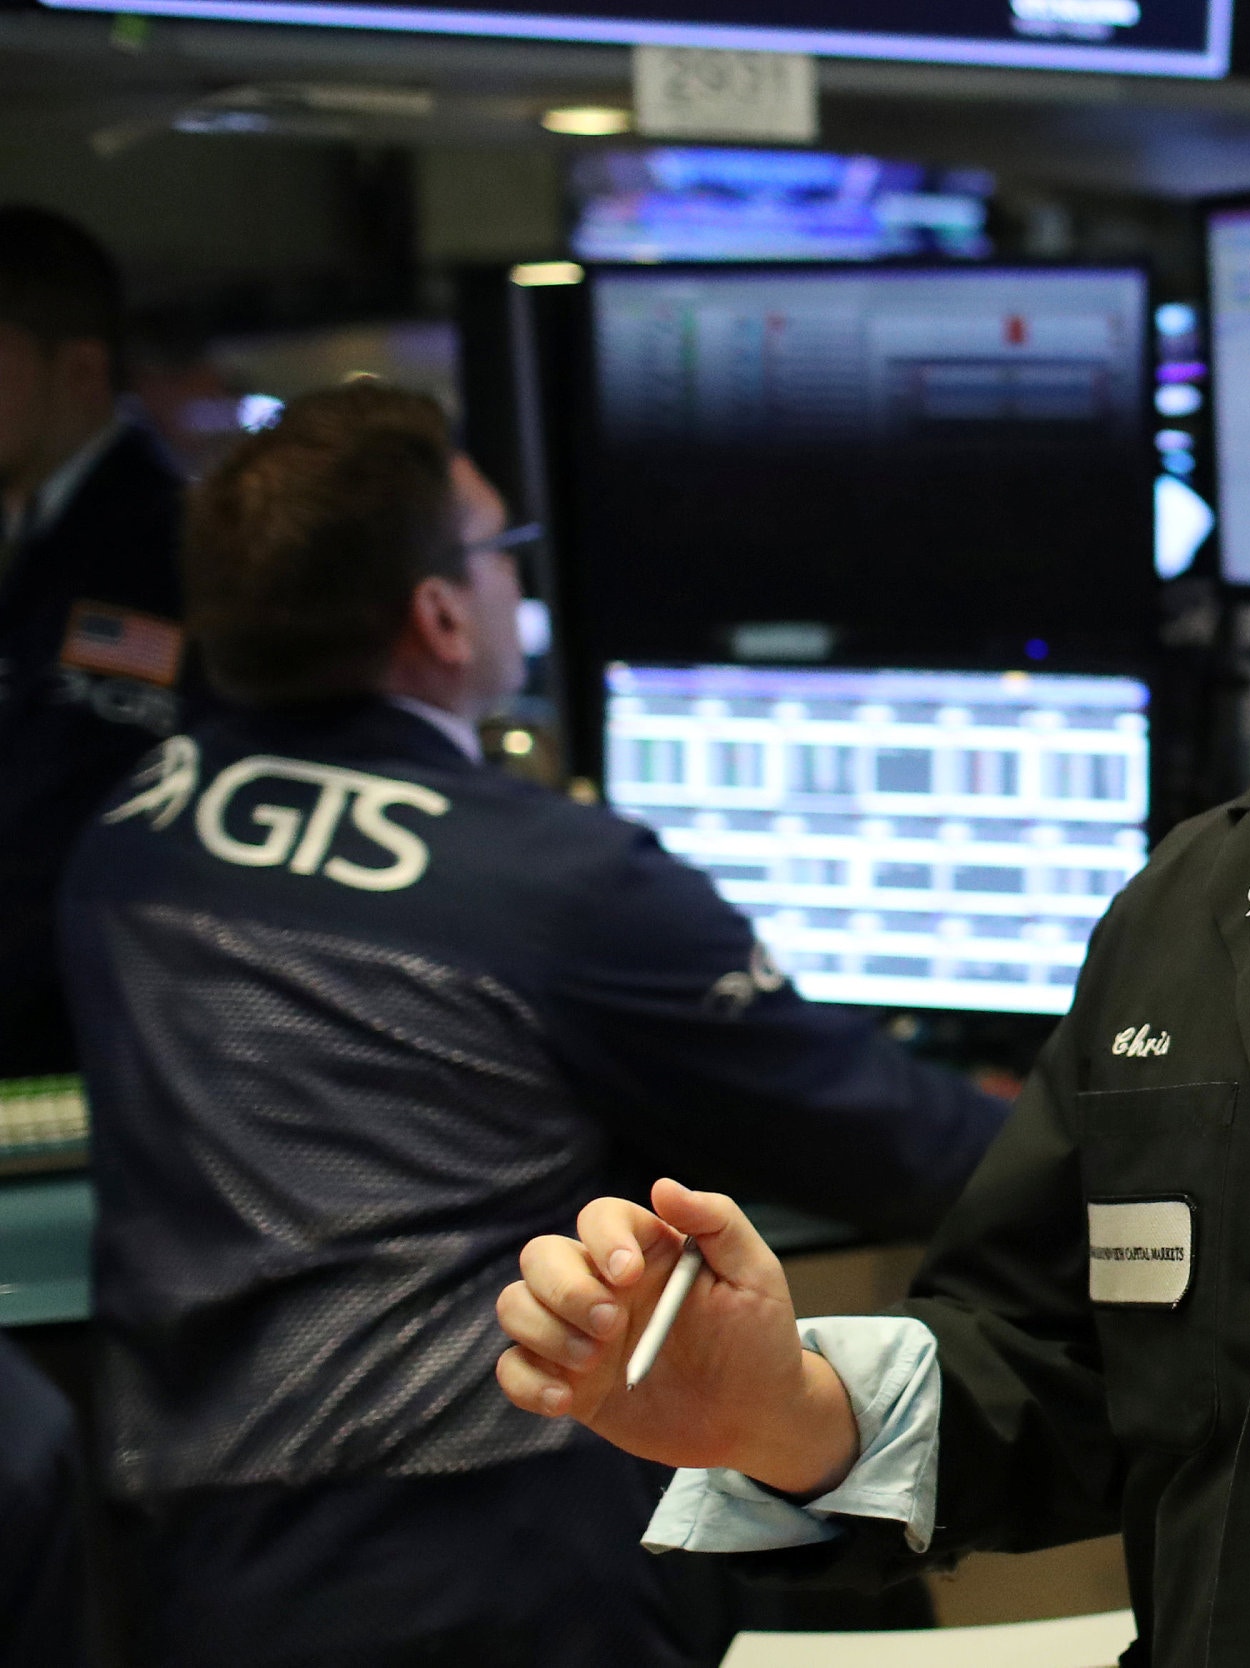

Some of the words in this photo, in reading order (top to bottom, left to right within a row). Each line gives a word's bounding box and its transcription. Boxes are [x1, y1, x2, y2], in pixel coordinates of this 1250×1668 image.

[196, 754, 449, 892] GTS
[1112, 1023, 1171, 1057] Chris
[1125, 1246, 1150, 1261] CAPITAL
[1151, 1246, 1184, 1261] MARKETS
